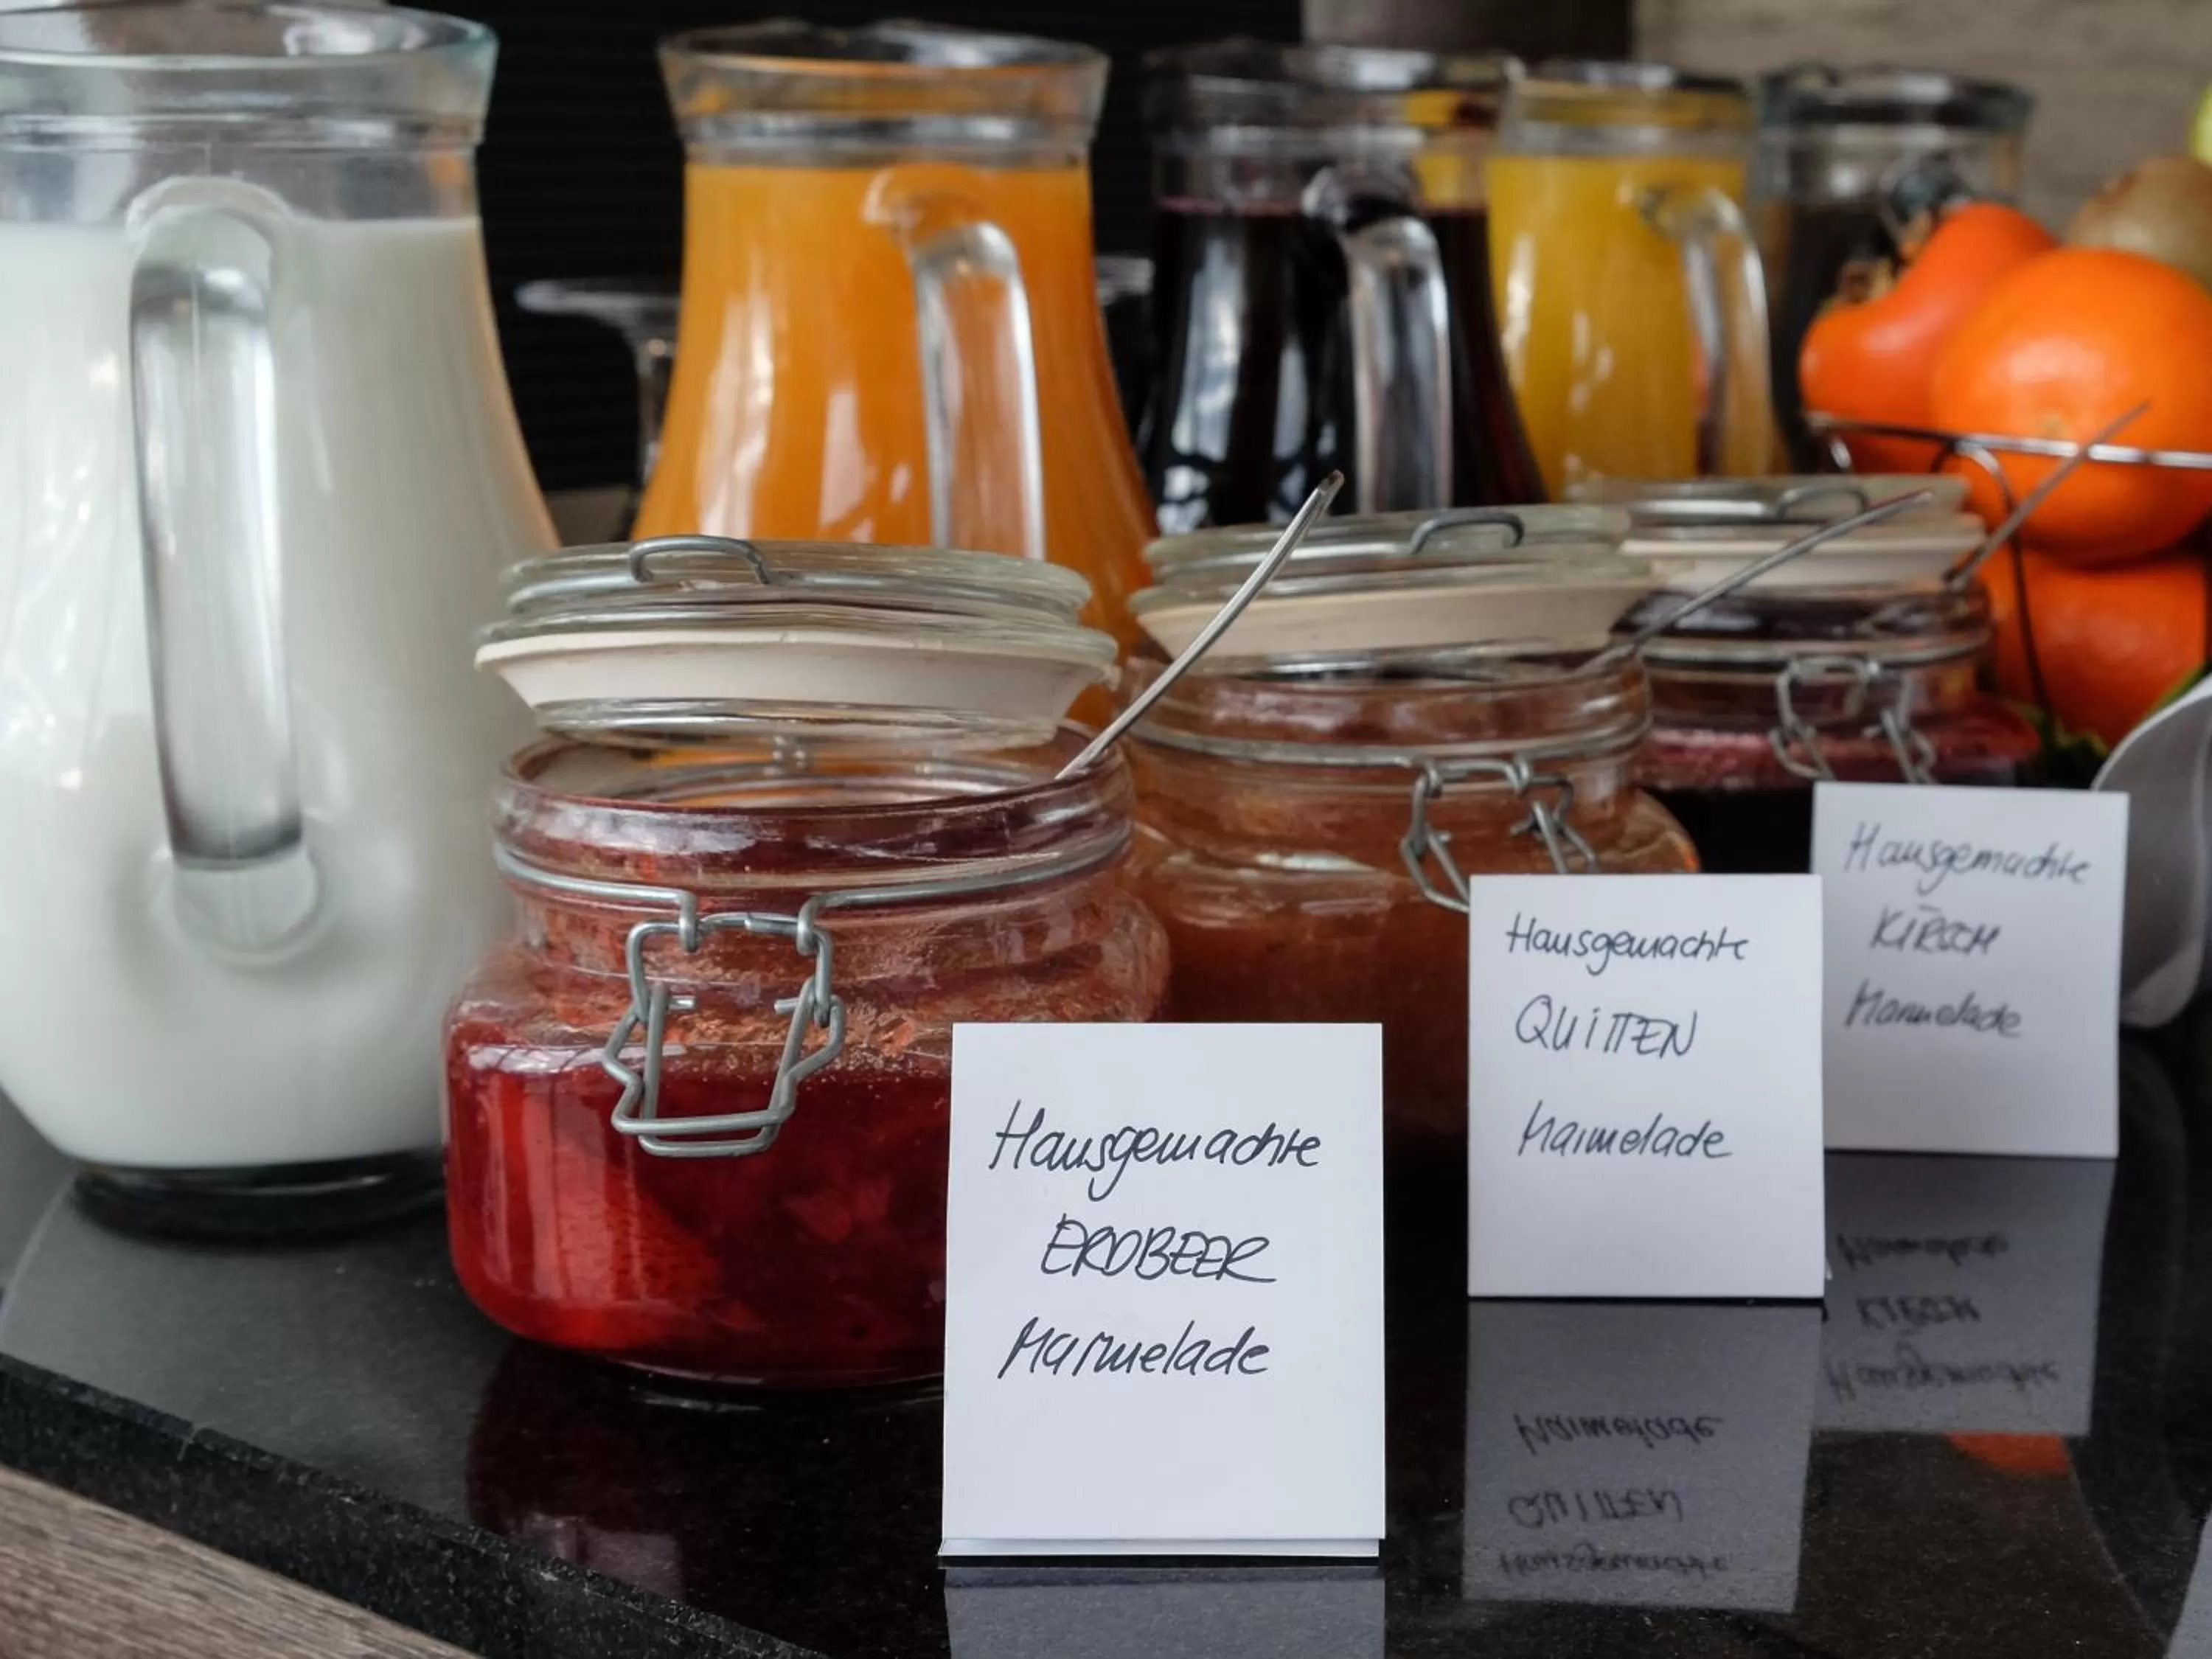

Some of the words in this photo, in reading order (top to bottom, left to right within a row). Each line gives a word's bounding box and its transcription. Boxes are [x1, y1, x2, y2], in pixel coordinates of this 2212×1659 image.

[1504, 911, 1749, 976] Hausgemachte
[988, 1099, 1321, 1202] Hausgemachte
[1040, 1212, 1277, 1283] ERDBEER
[996, 1316, 1270, 1380] Marmelade
